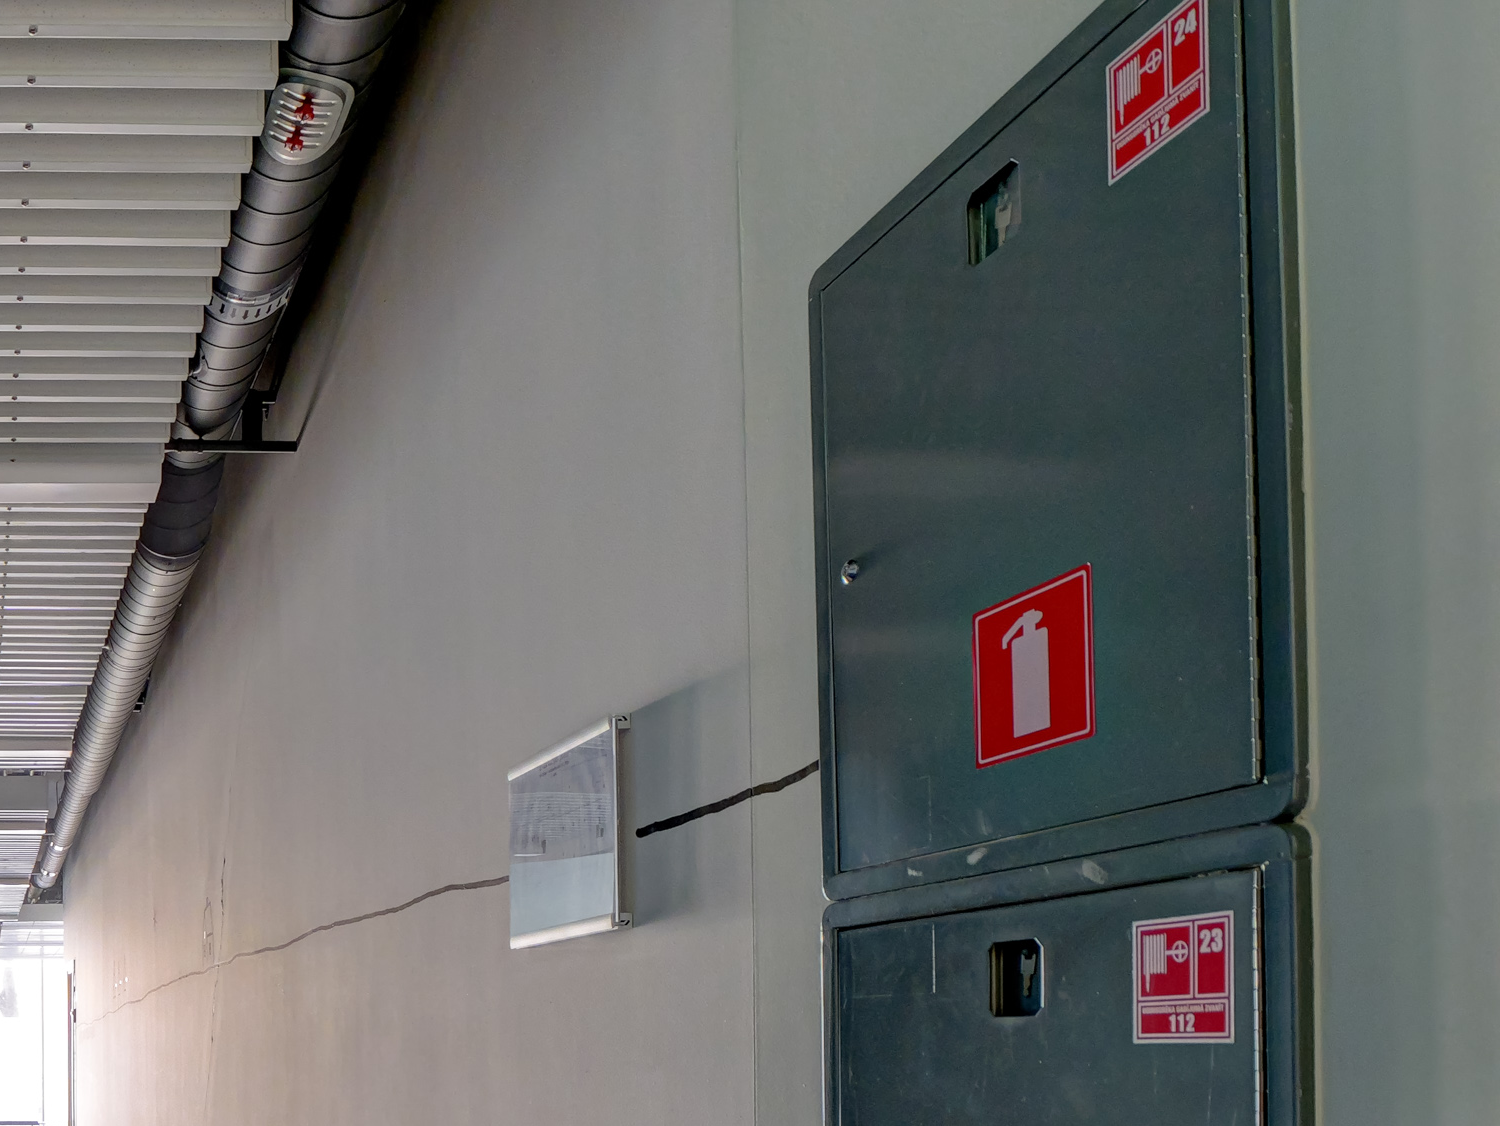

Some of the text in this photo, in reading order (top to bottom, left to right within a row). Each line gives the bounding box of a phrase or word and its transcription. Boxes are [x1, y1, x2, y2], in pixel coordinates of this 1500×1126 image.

[1174, 8, 1197, 46] 24
[1143, 113, 1171, 147] 112
[1199, 928, 1223, 953] 23
[1169, 1013, 1195, 1033] 112
